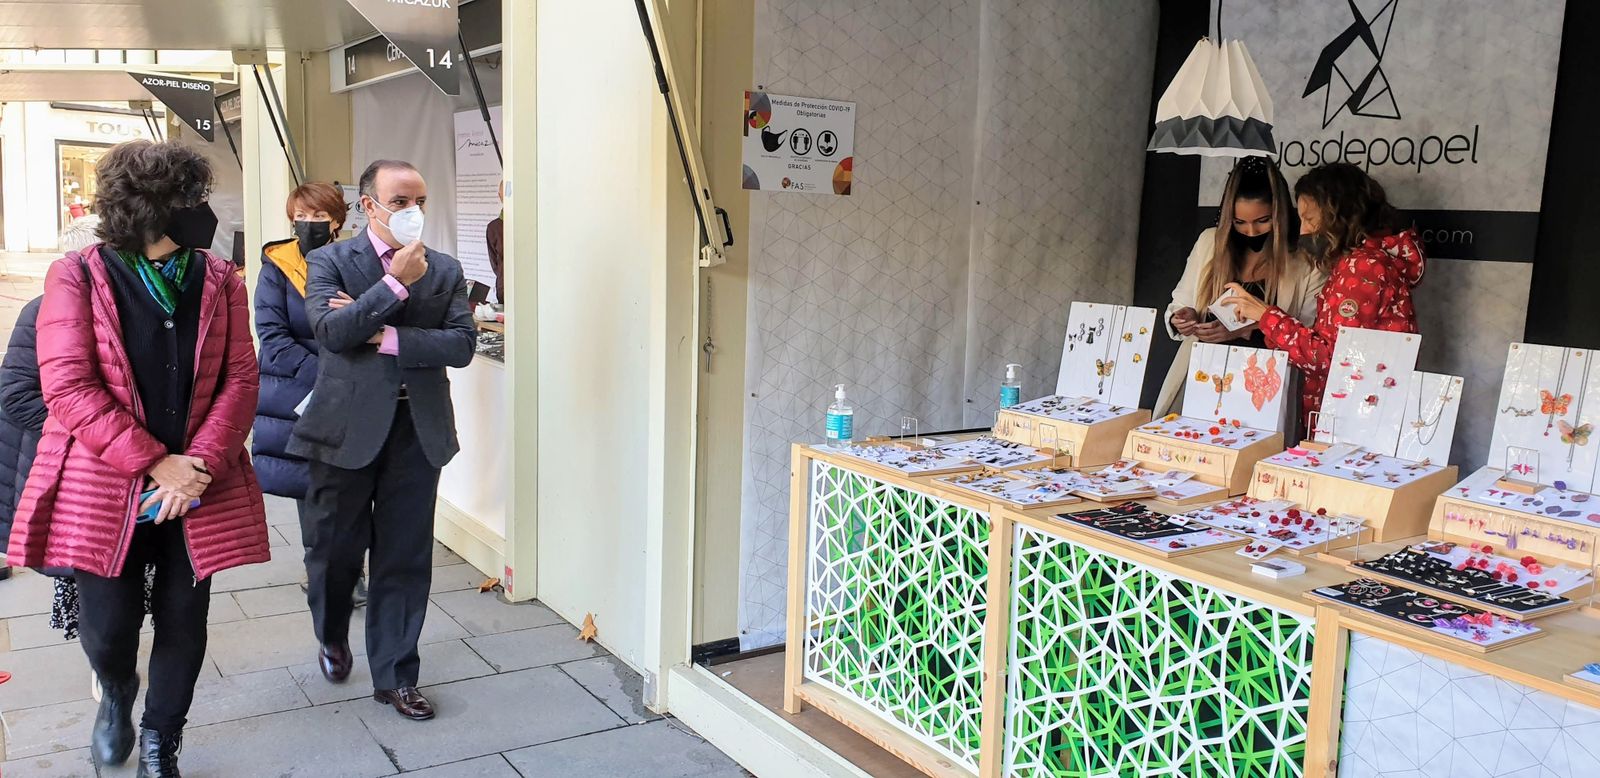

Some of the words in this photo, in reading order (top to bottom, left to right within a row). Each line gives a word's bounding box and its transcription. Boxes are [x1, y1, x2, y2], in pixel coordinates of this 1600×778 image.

[347, 55, 356, 75] 14
[426, 48, 453, 69] 14
[142, 77, 180, 89] AZOR-PIEL
[181, 81, 211, 92] DISEÑO
[771, 99, 793, 107] Medidas
[801, 102, 828, 111] Protección
[828, 104, 851, 112] COVID-19
[796, 110, 826, 119] Obligatorias
[86, 120, 142, 137] TOUS
[195, 118, 211, 131] 15
[787, 163, 812, 171] GRACIAS
[791, 182, 805, 191] FAS
